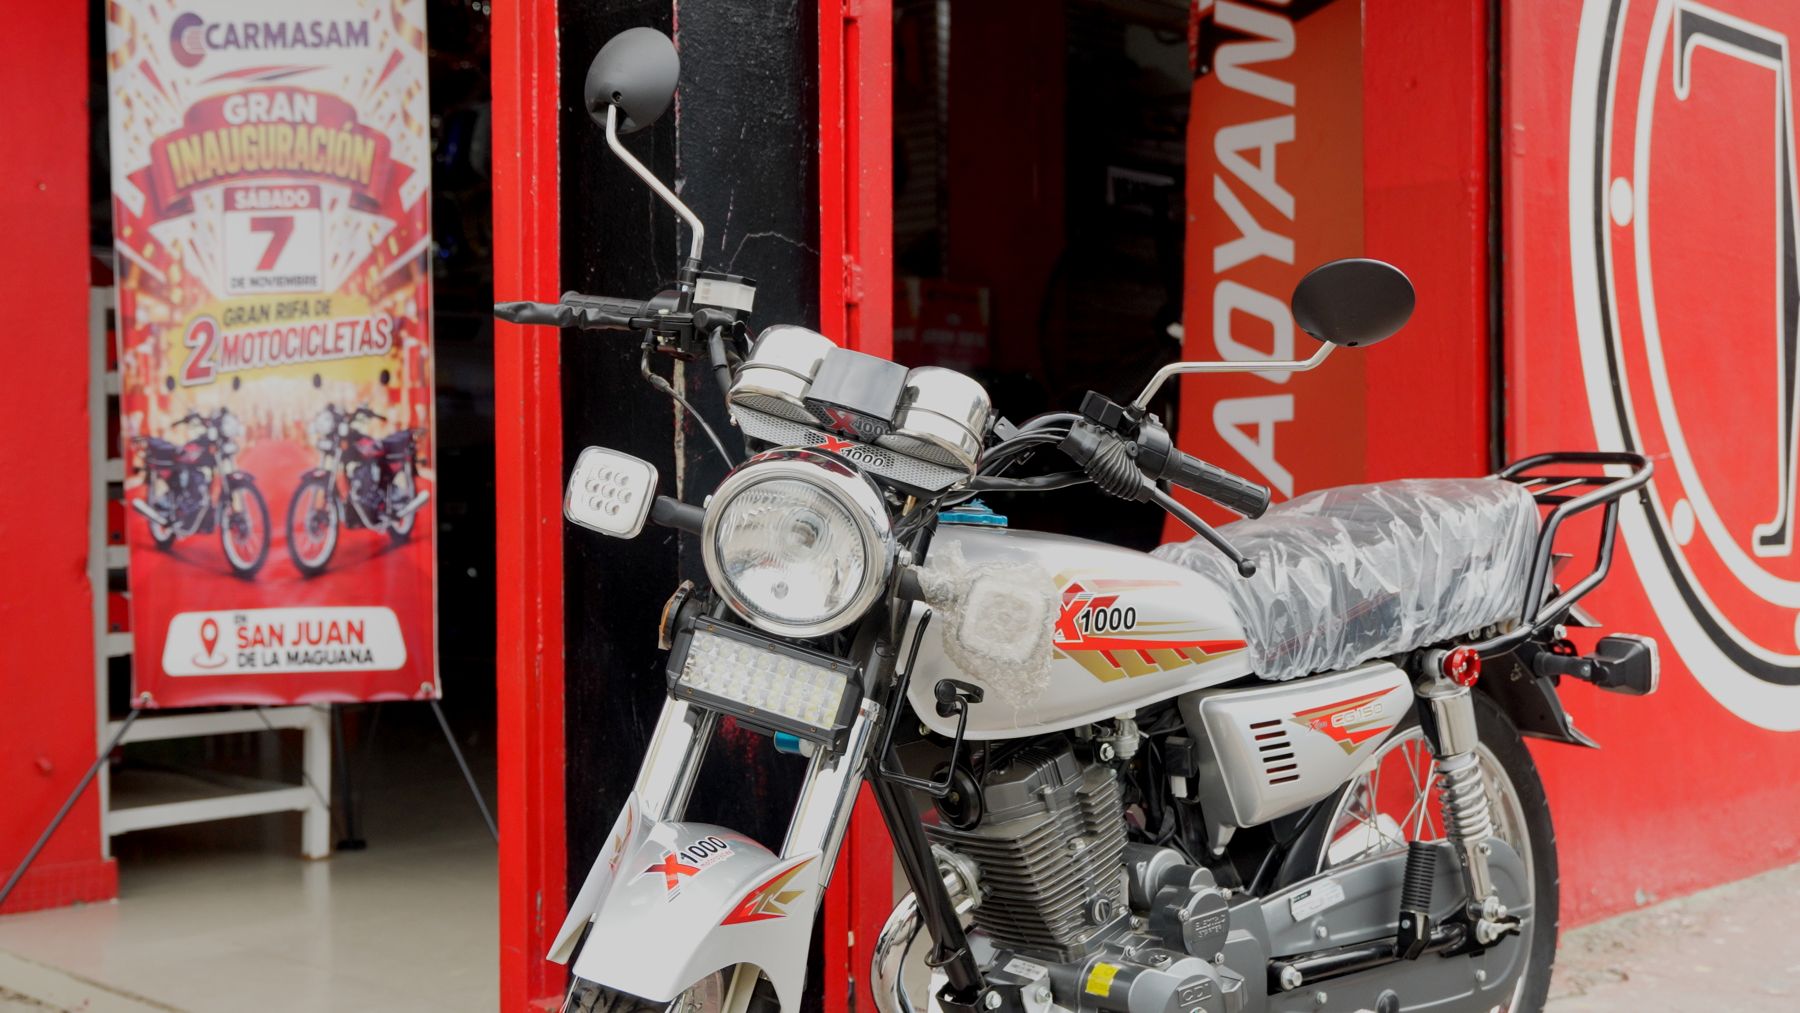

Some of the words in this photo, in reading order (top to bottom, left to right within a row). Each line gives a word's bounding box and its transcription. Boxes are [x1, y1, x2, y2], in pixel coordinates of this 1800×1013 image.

[205, 20, 369, 50] CARMASAM
[223, 92, 318, 125] GRAN
[166, 121, 376, 190] INAUGURACIÓN
[234, 188, 311, 210] SÁBADO
[249, 216, 295, 272] 7
[1213, 0, 1296, 500] AOYAN
[223, 306, 270, 326] GRAN
[276, 302, 311, 321] RIFA
[314, 299, 331, 315] DE
[184, 319, 215, 381] 2
[219, 317, 390, 368] MOTOCICLETAS
[817, 433, 885, 468] X1000
[237, 623, 284, 649] SAN
[291, 619, 365, 646] JUAN
[238, 652, 257, 668] DE
[263, 651, 280, 667] LA
[287, 648, 375, 666] MAGUANA
[643, 836, 729, 892] X1000
